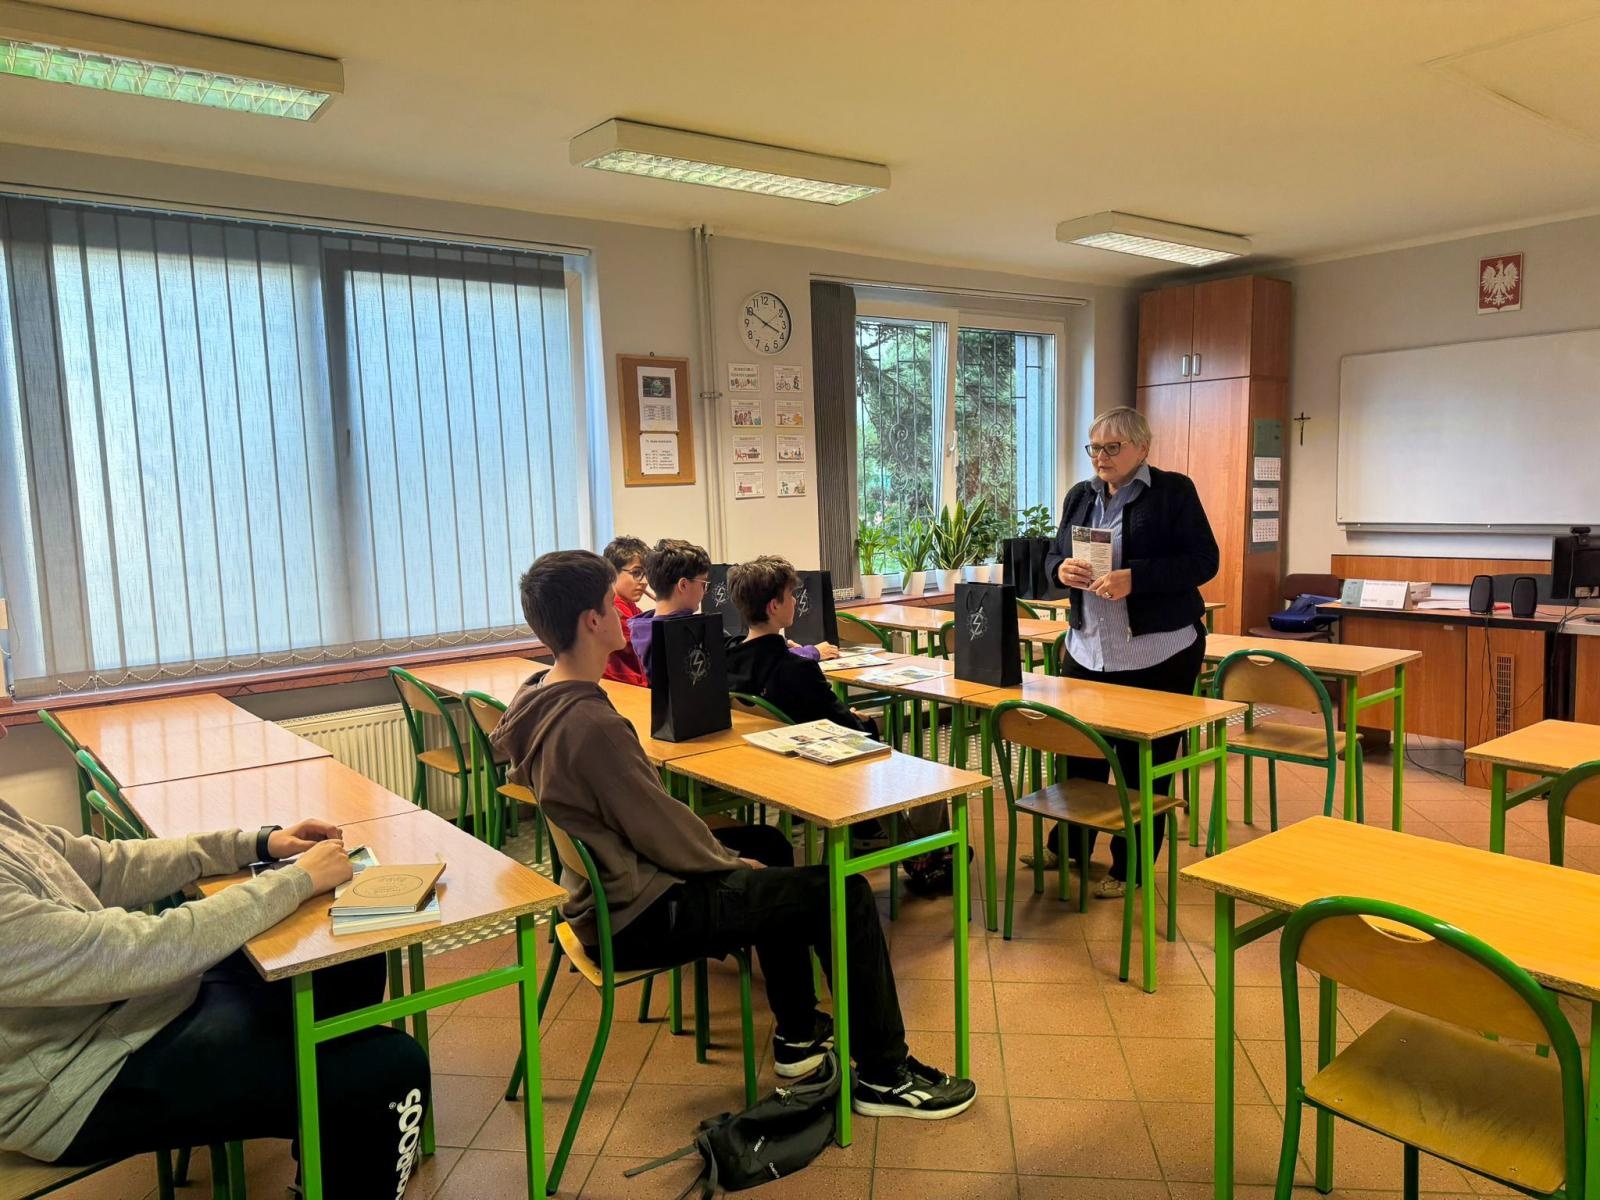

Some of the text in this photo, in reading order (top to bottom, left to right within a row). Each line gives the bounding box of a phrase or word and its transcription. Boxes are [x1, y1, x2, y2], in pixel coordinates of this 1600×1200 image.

[752, 299, 759, 308] 11
[760, 296, 769, 305] 12
[778, 309, 784, 318] 2
[744, 319, 750, 327] 9
[781, 321, 786, 330] 3
[747, 330, 753, 339] 8
[755, 339, 760, 349] 7
[765, 342, 770, 352] 6
[773, 340, 778, 349] 5
[892, 1081, 913, 1095] Reebok
